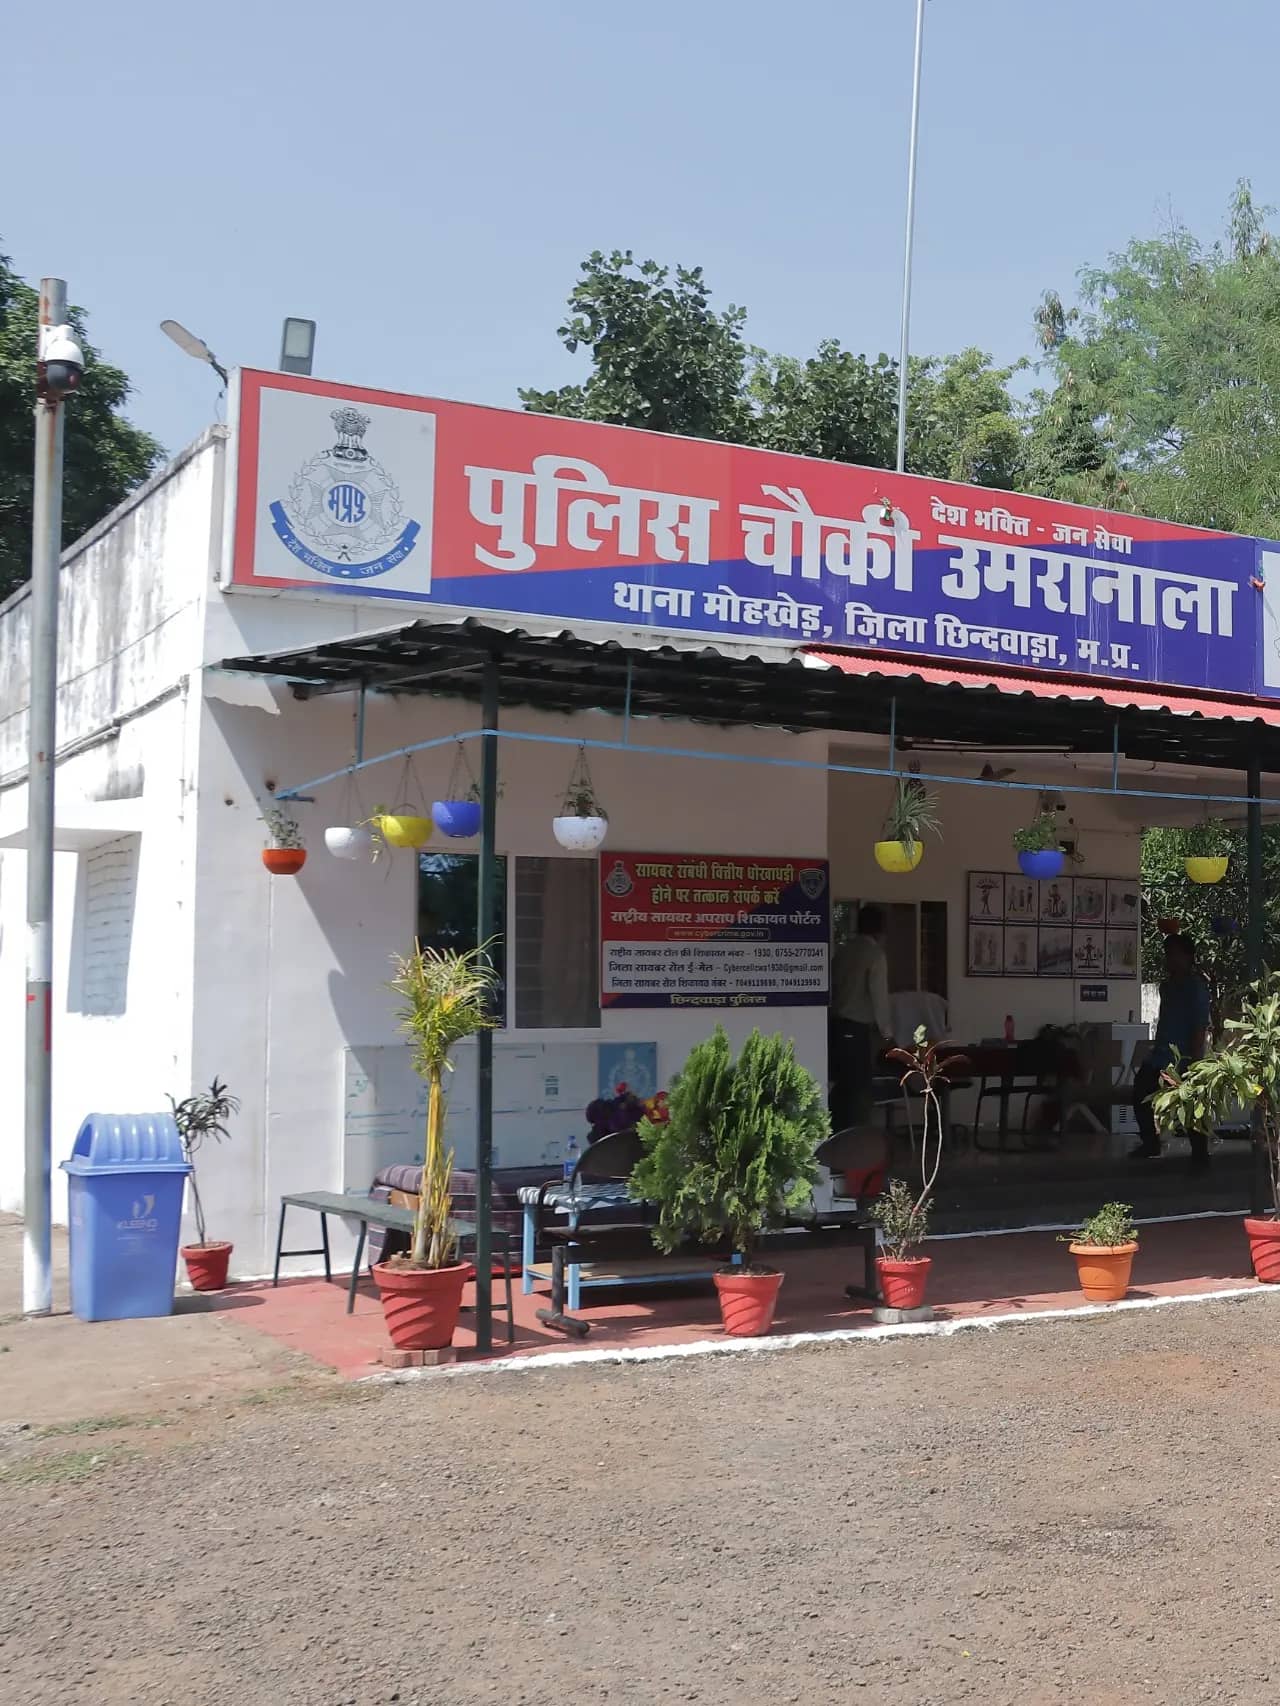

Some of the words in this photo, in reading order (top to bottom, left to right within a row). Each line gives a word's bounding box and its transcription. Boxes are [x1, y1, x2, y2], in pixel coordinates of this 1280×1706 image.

[930, 496, 968, 527] देश
[974, 507, 1030, 537] भक्ति
[1052, 522, 1088, 547] जन
[1094, 525, 1133, 554] सेवा
[464, 454, 720, 571] पुलिस
[738, 484, 921, 592] चौकी
[938, 534, 1238, 638] उमरानाला
[614, 582, 695, 617] थाना
[1076, 638, 1140, 670] म.प्र.
[635, 863, 673, 878] सायबर
[651, 884, 672, 904] होने
[675, 888, 690, 903] पर
[693, 888, 730, 904] तत्काल
[610, 908, 648, 925] राष्ट्रीय
[650, 912, 692, 923] सायबर
[736, 910, 787, 925] शिकायत
[789, 910, 822, 925] पोर्टल
[728, 993, 767, 1006] पुलिस
